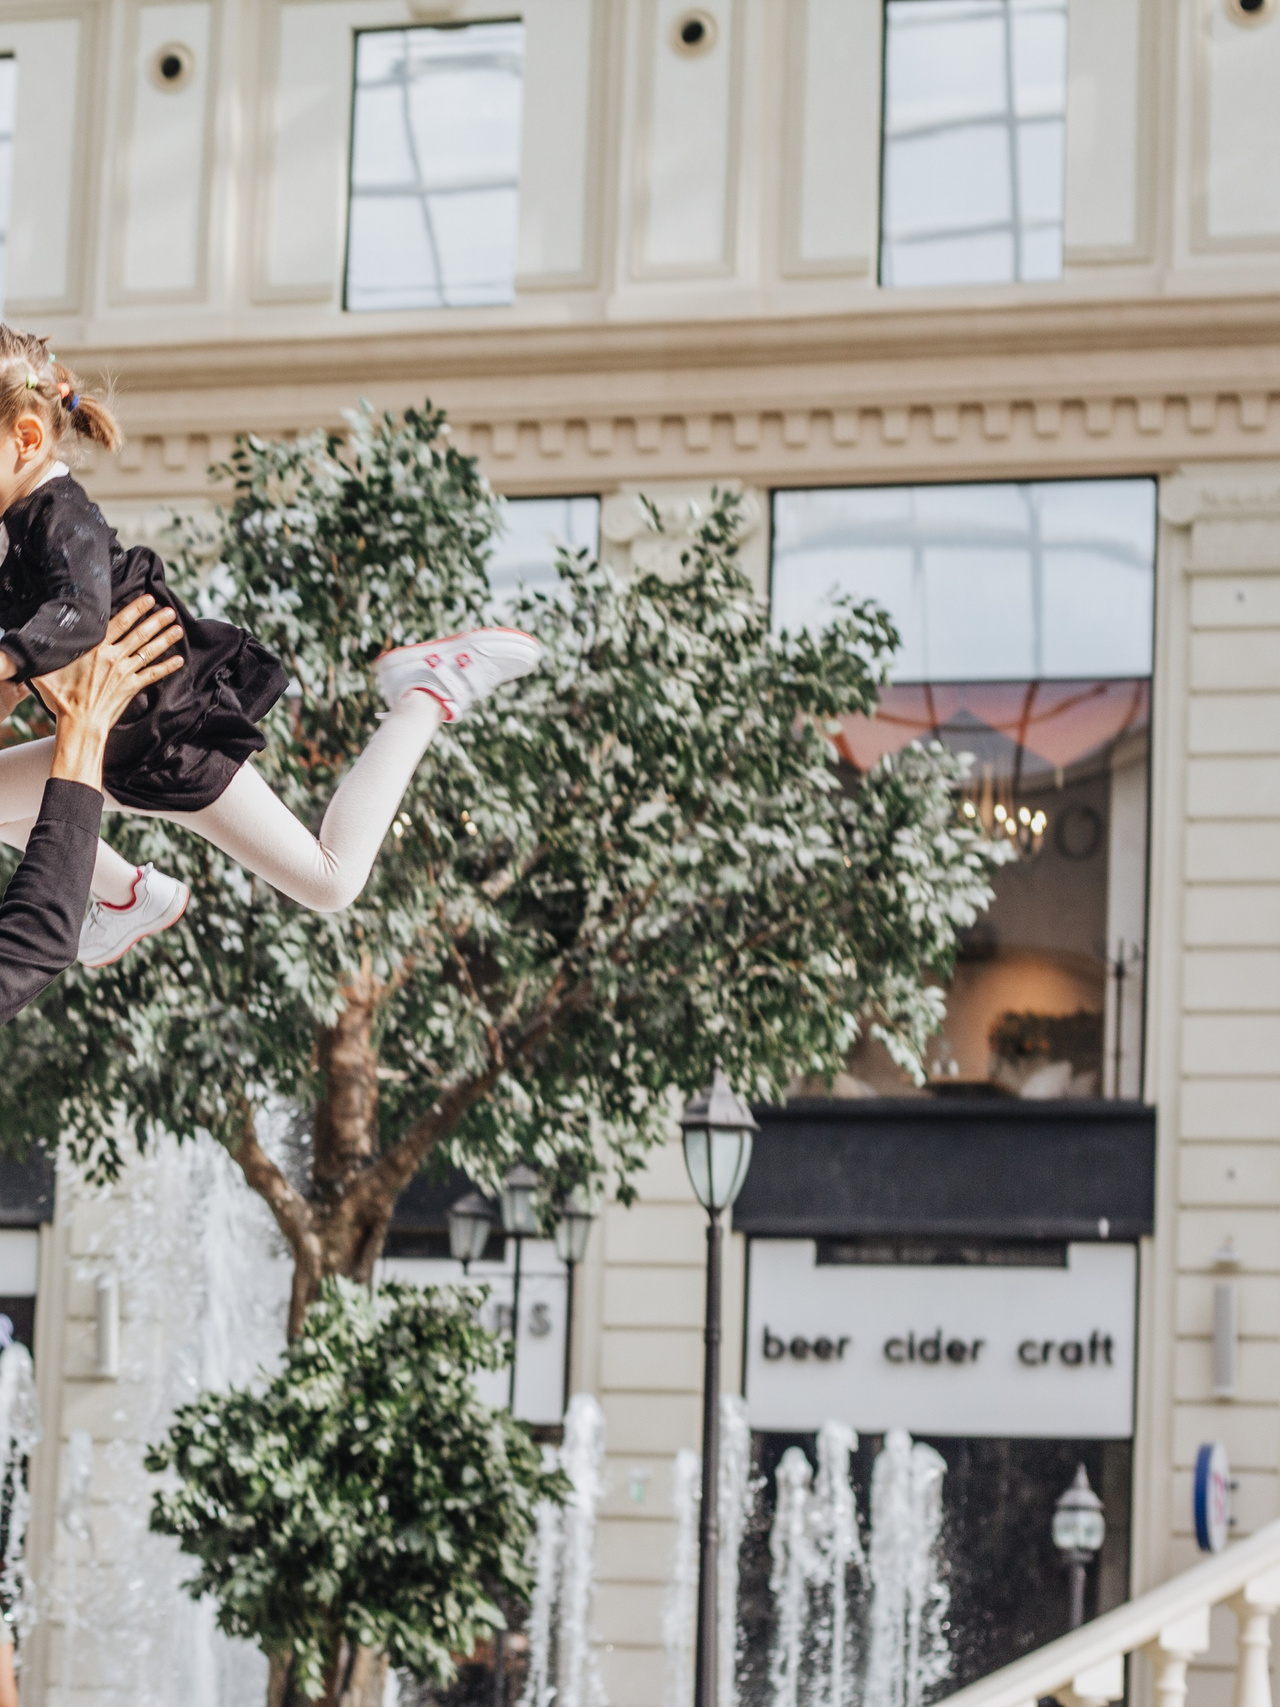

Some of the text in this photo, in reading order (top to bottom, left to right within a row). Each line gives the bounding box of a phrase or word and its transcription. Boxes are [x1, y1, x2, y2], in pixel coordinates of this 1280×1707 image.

[762, 1323, 1114, 1366] beer cider craft
